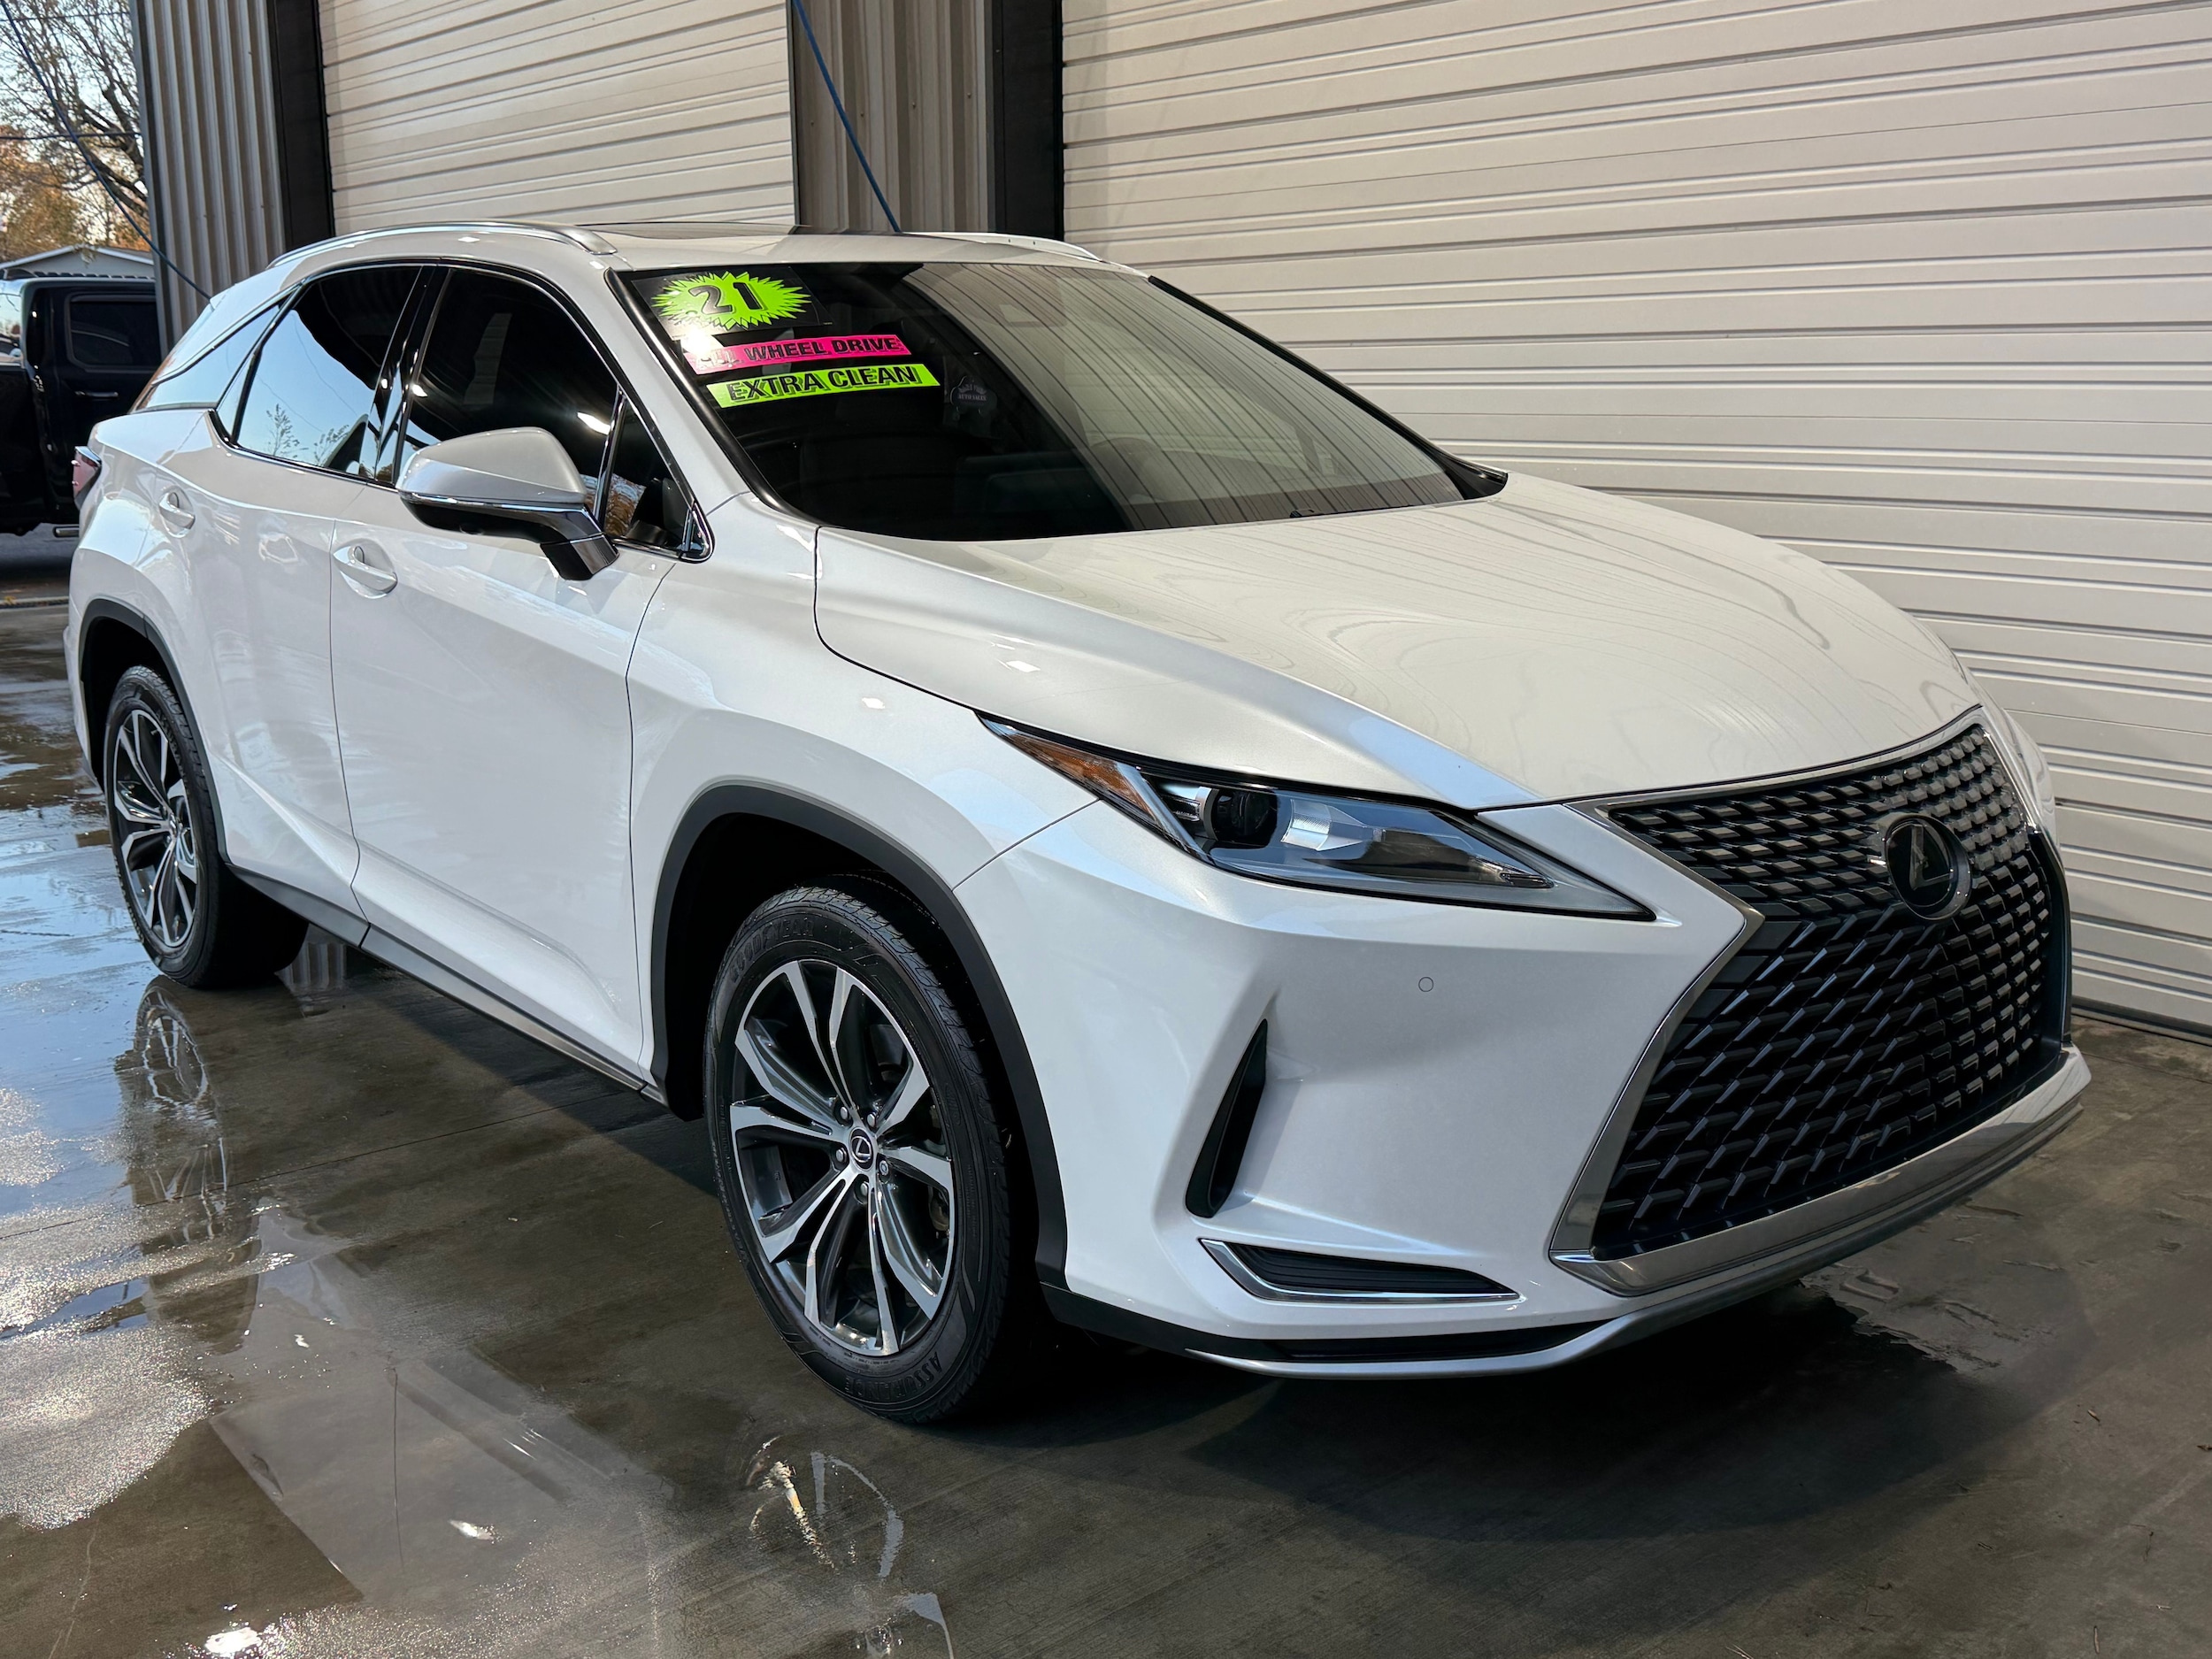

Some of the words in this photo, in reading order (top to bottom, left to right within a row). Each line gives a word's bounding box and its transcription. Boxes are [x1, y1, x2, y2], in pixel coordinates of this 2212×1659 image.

[688, 281, 764, 315] 21
[744, 340, 828, 361] WHEEL
[831, 337, 902, 354] DRIVE
[726, 373, 825, 402] EXTRA
[827, 365, 919, 388] CLEAN
